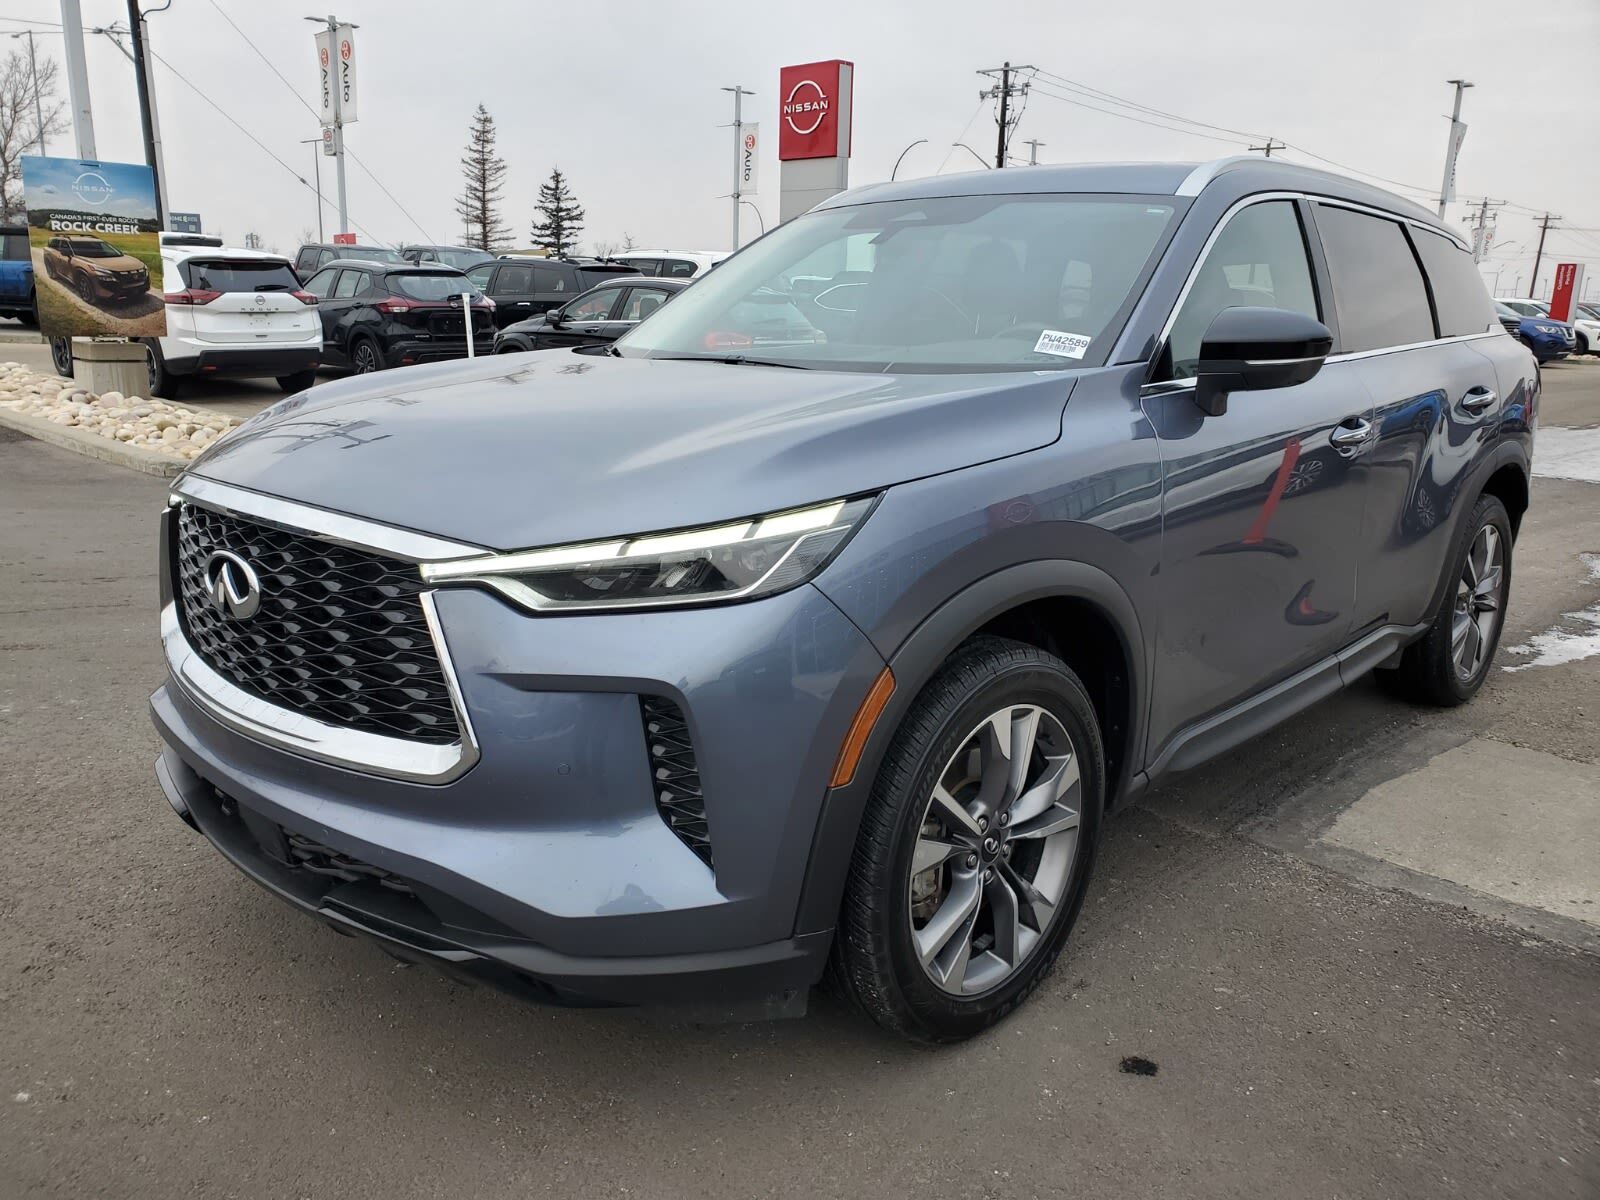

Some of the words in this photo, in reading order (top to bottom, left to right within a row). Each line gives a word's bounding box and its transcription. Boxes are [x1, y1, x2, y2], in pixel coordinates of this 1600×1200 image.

[342, 61, 350, 103] Auto
[783, 100, 829, 114] NISSAN
[744, 150, 752, 182] Auto
[71, 184, 113, 194] NISSAN
[51, 220, 93, 232] ROCK
[95, 223, 140, 235] CREEK
[1042, 333, 1089, 348] PW42589
